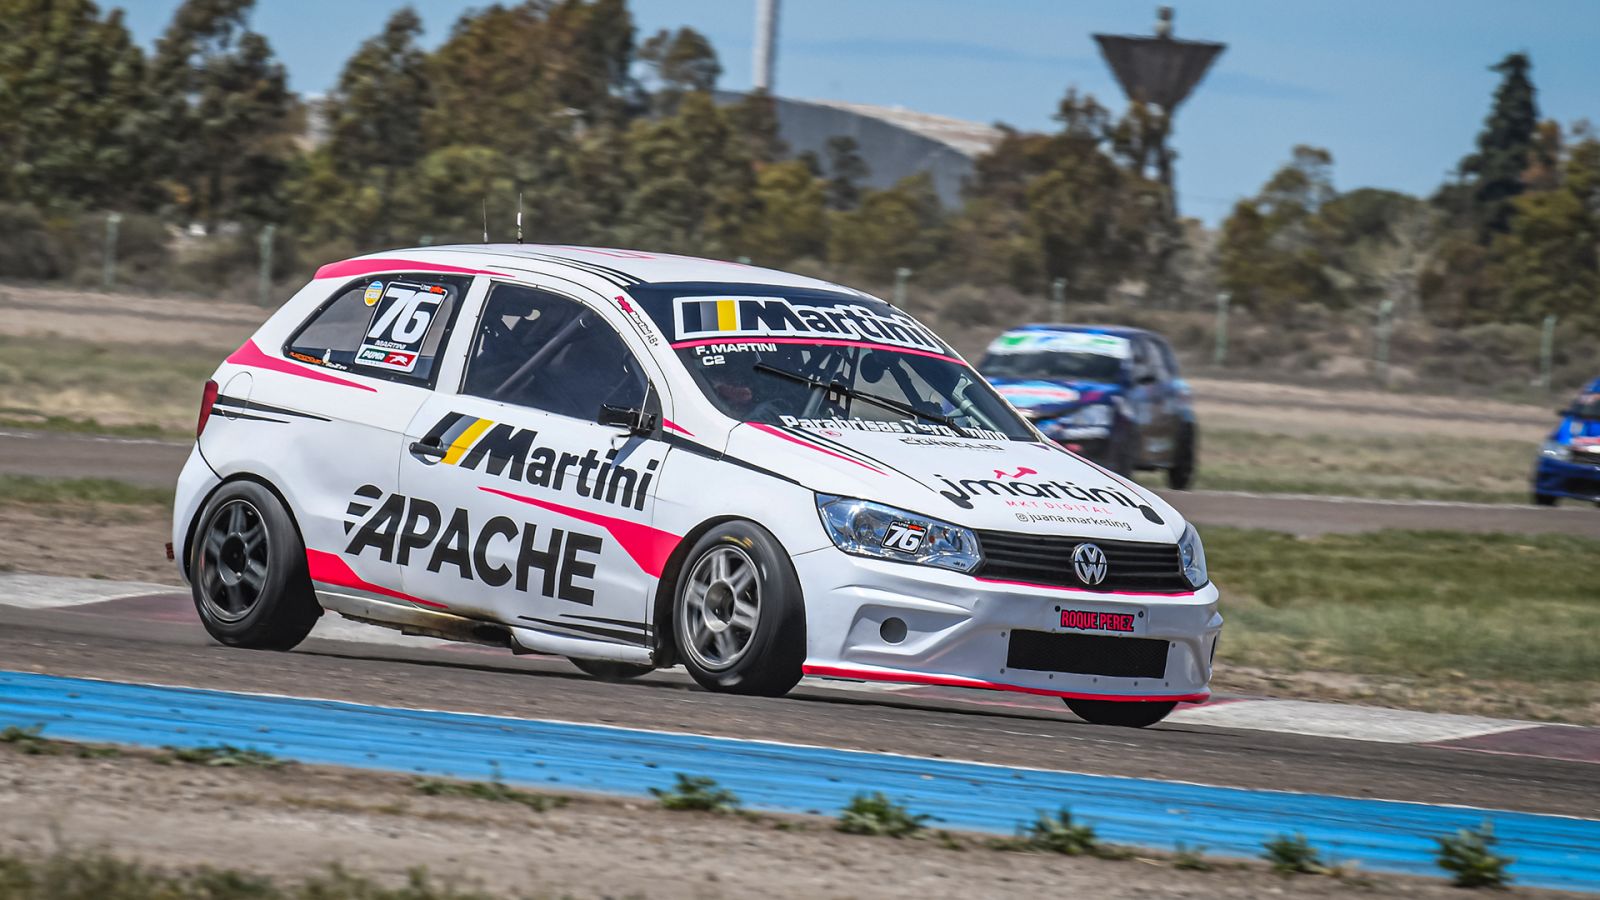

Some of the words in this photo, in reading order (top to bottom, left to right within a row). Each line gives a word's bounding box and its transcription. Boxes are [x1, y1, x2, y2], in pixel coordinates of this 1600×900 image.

[367, 287, 443, 343] 76
[738, 299, 941, 349] Martini
[374, 340, 407, 350] MARTINI
[695, 346, 710, 355] F.
[711, 343, 777, 354] MARTINI
[702, 355, 726, 366] C2
[779, 415, 906, 433] Parabrisas
[459, 422, 660, 511] Martini
[1006, 500, 1038, 508] MKT
[1044, 502, 1113, 515] DIGITAL
[885, 525, 924, 551] 76
[344, 493, 603, 607] APACHE
[1061, 610, 1099, 630] ROQUE
[1099, 612, 1135, 632] PEREZ
